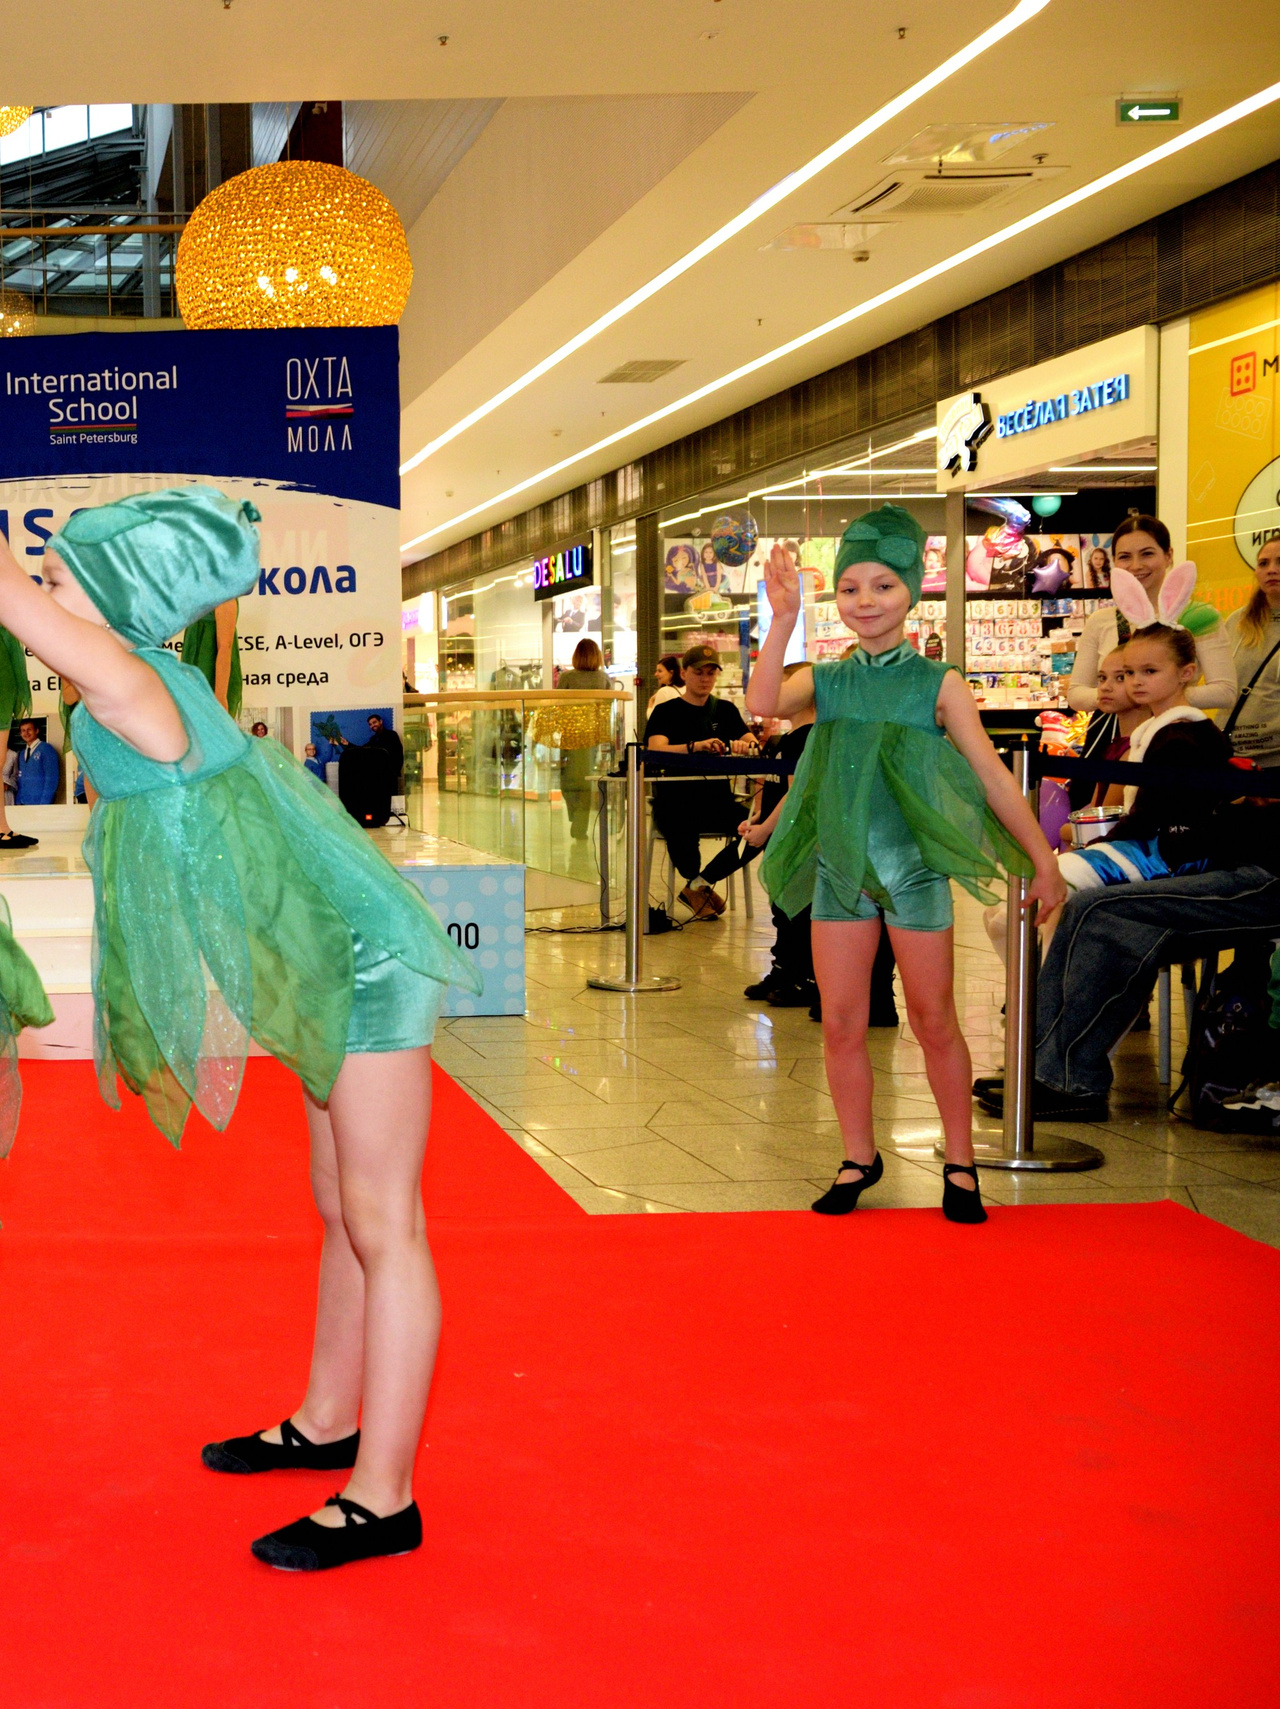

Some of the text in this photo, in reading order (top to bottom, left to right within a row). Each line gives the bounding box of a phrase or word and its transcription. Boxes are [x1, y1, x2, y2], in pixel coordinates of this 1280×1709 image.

[6, 365, 178, 395] International
[286, 356, 353, 400] ОХТА
[48, 395, 138, 423] School
[996, 394, 1068, 439] ВЕСЁЛАЯ
[1070, 373, 1129, 416] ЗАТЕЯ
[49, 432, 138, 445] Saint Petersburg
[244, 564, 357, 596] кола
[533, 545, 583, 590] DESALU
[275, 633, 344, 650] A-Level,
[349, 631, 384, 648] ОГЭ
[276, 671, 329, 688] среда
